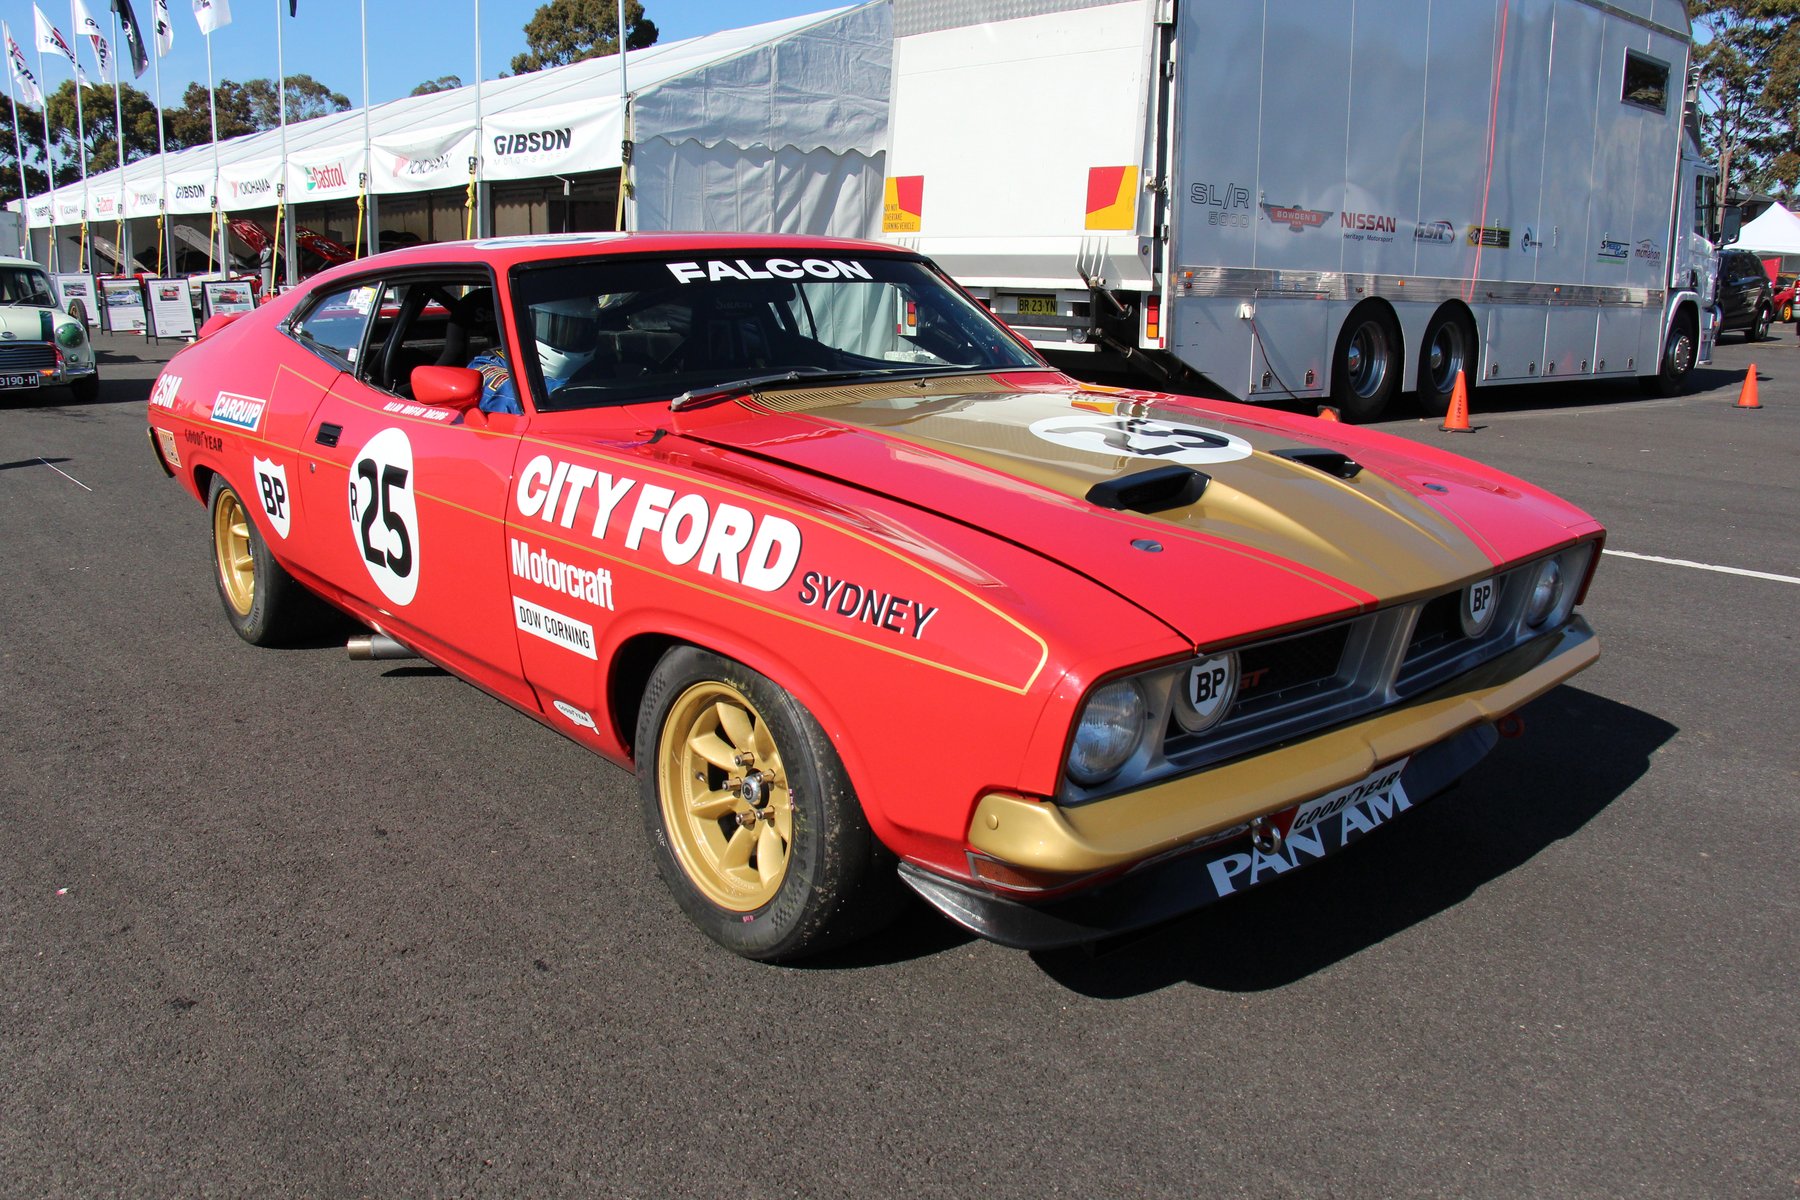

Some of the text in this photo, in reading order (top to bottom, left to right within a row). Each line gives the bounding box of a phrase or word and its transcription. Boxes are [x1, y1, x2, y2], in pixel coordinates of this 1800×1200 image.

[494, 127, 572, 156] GIBSON
[239, 178, 271, 196] YOKOHAMA
[312, 162, 347, 190] Castrol
[175, 184, 206, 199] GIBSON
[1190, 182, 1250, 210] SL/R
[1207, 211, 1250, 229] 5000
[1340, 211, 1397, 233] NISSAN
[1343, 232, 1394, 244] Heritage Motorsport
[666, 258, 874, 284] FALCON
[152, 373, 183, 409] 2SM
[214, 396, 261, 425] CARQUIP
[422, 408, 449, 421] RACING
[259, 471, 285, 520] BP
[350, 457, 413, 578] R 25
[516, 454, 803, 593] CITY FORD
[510, 537, 615, 612] Motorcraft
[798, 571, 939, 641] SYDNEY
[1473, 585, 1491, 612] BP
[519, 605, 591, 650] DOW CORNING
[1196, 667, 1226, 704] BP
[1206, 821, 1326, 897] PAN
[1340, 777, 1413, 847] AM
